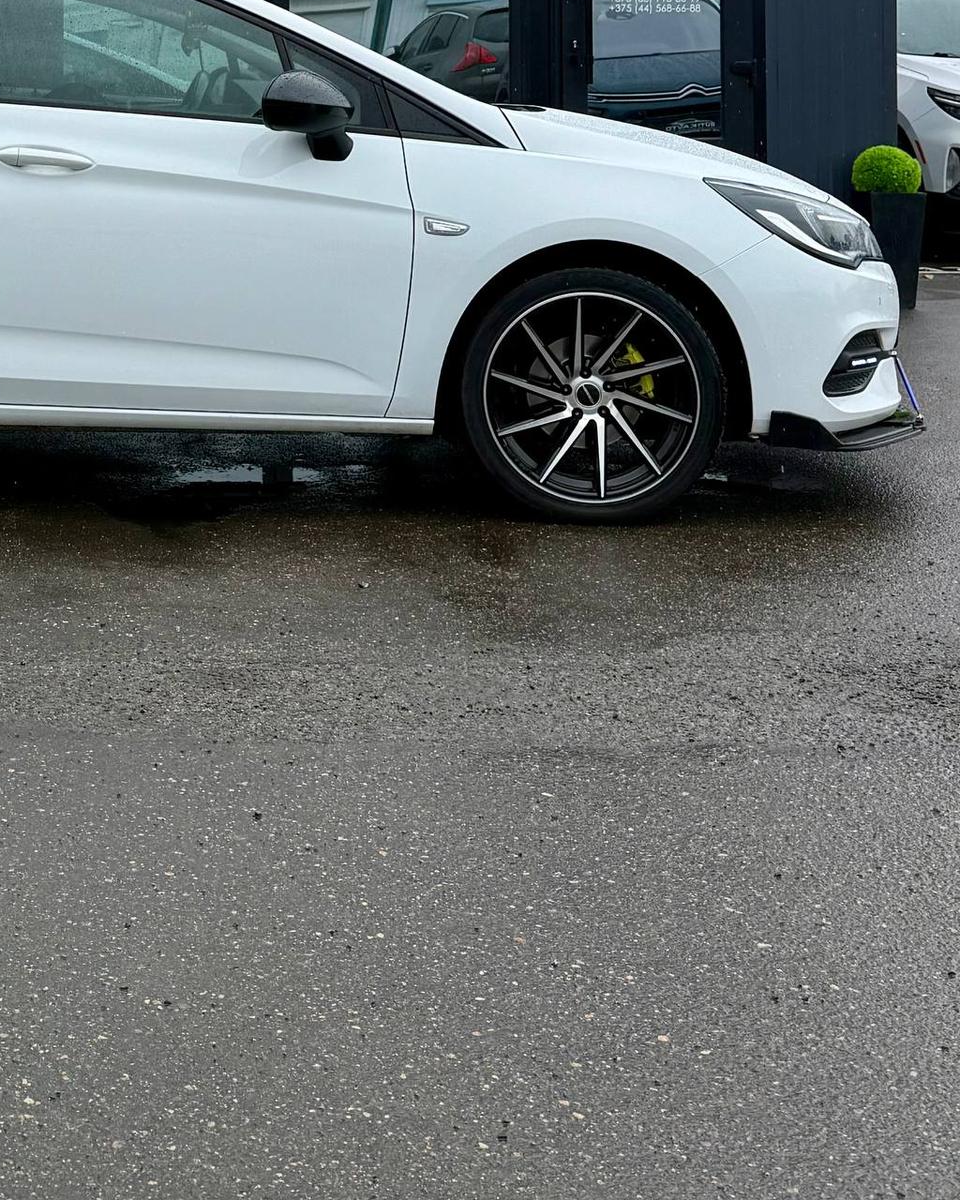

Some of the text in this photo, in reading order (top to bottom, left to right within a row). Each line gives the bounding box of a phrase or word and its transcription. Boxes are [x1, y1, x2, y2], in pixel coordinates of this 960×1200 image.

[609, 3, 701, 15] +375 (44) 568-66-88
